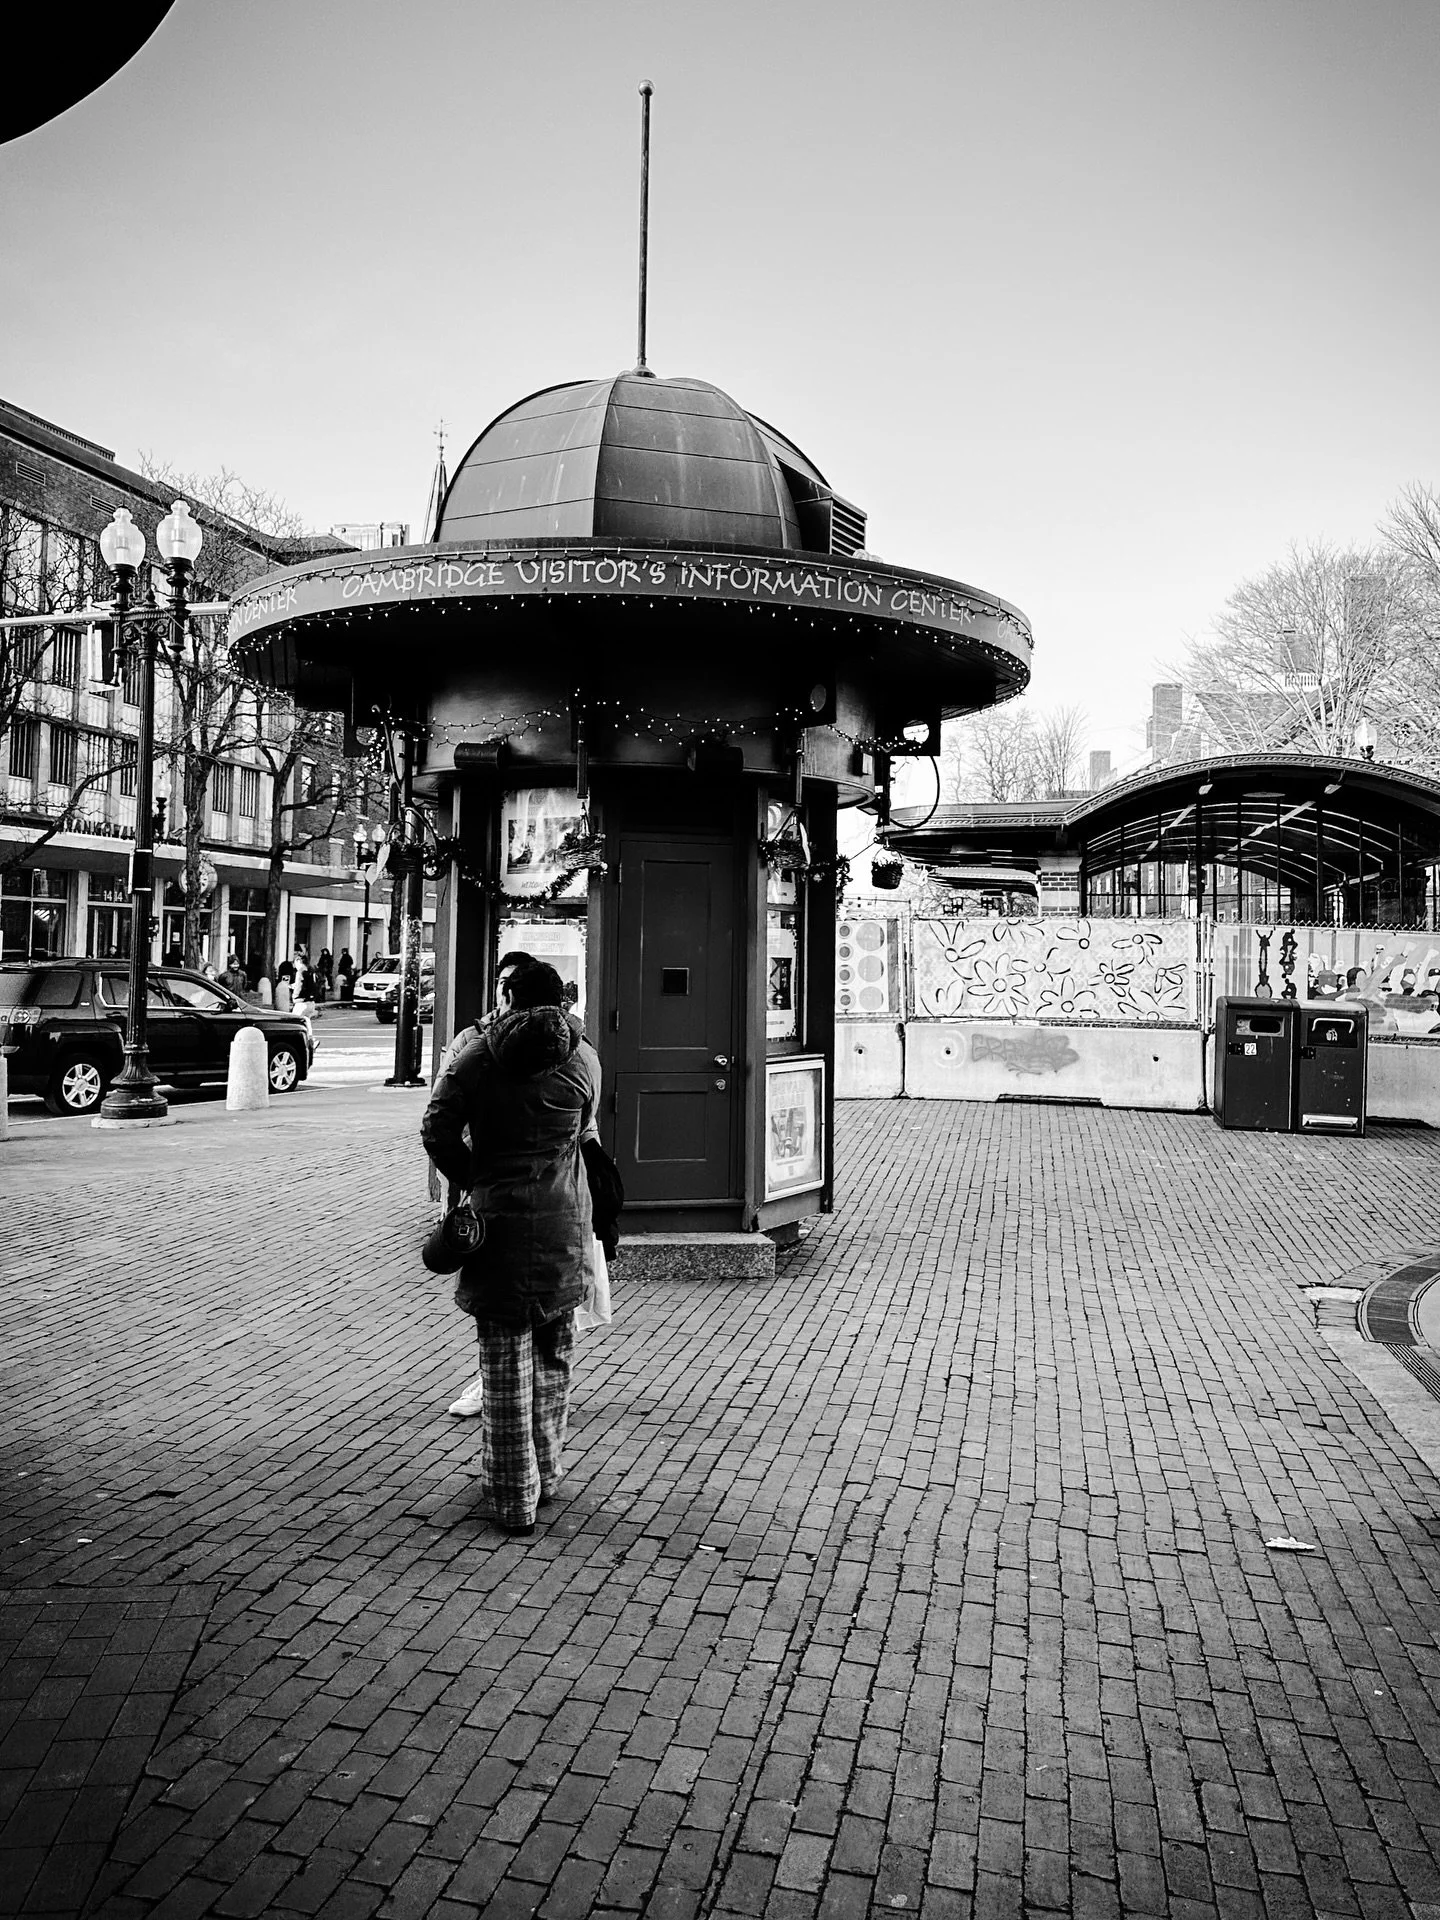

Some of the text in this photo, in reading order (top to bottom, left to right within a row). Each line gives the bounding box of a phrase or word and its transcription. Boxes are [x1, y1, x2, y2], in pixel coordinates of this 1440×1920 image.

[244, 585, 298, 624] CENTER
[341, 559, 972, 627] CAMBRIDGE VISITOR'S INFORMATION CENTER
[103, 890, 123, 902] 1414
[1245, 1044, 1256, 1055] 22
